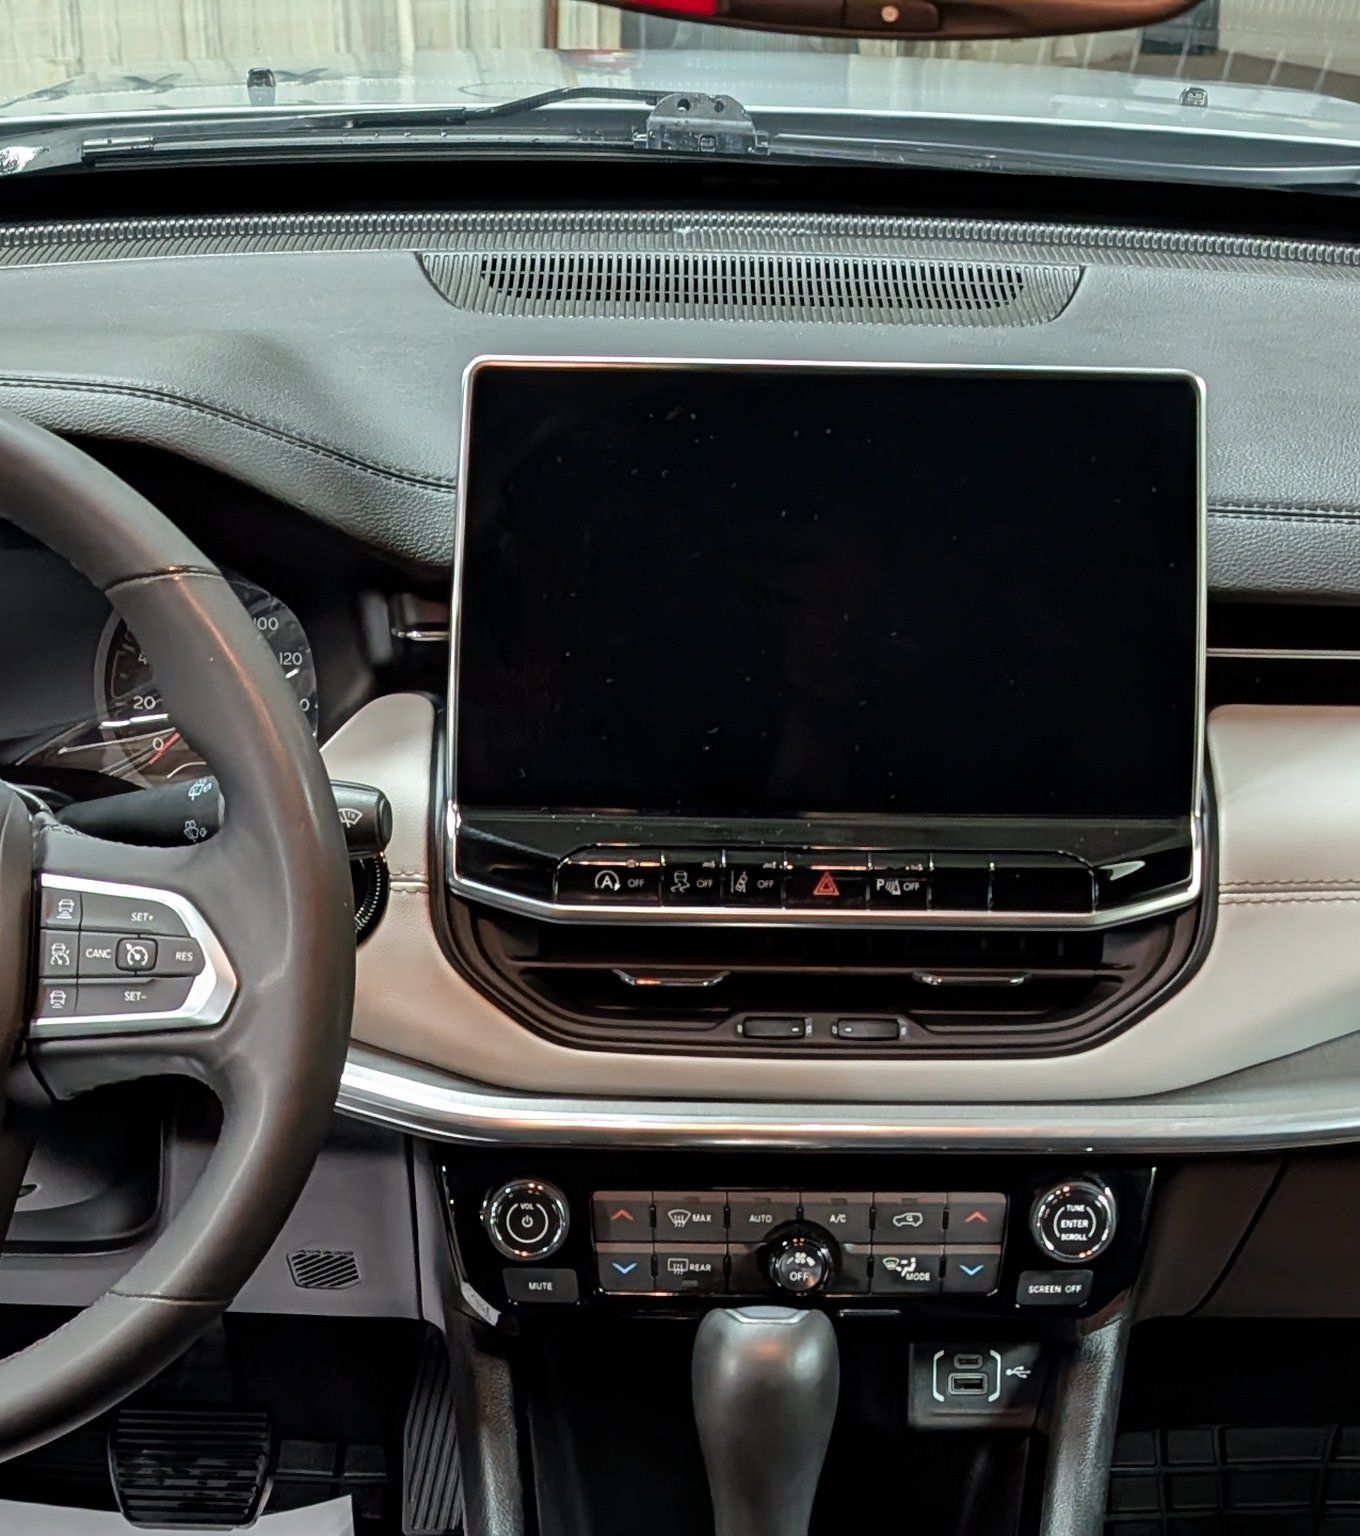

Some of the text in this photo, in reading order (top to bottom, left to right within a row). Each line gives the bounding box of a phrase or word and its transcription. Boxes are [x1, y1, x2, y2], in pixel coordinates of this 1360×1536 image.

[279, 652, 303, 666] 120
[131, 695, 157, 710] 20
[627, 878, 645, 889] OFF
[696, 878, 713, 889] OFF
[757, 878, 775, 890] OFF
[902, 881, 920, 892] OFF
[85, 948, 112, 959] CANC
[175, 952, 194, 962] RES
[520, 1202, 534, 1211] VOL
[1065, 1204, 1086, 1213] TUNE
[692, 1213, 713, 1223] MAX
[749, 1214, 773, 1224] AUTO
[829, 1214, 847, 1224] A/C
[1060, 1219, 1090, 1229] ENTER
[1060, 1233, 1088, 1241] SCROLL
[689, 1263, 712, 1273] REAR
[789, 1271, 809, 1282] OFF
[906, 1272, 931, 1282] MODE
[528, 1281, 553, 1292] MUTE
[1027, 1284, 1083, 1294] SCREEN OFF
